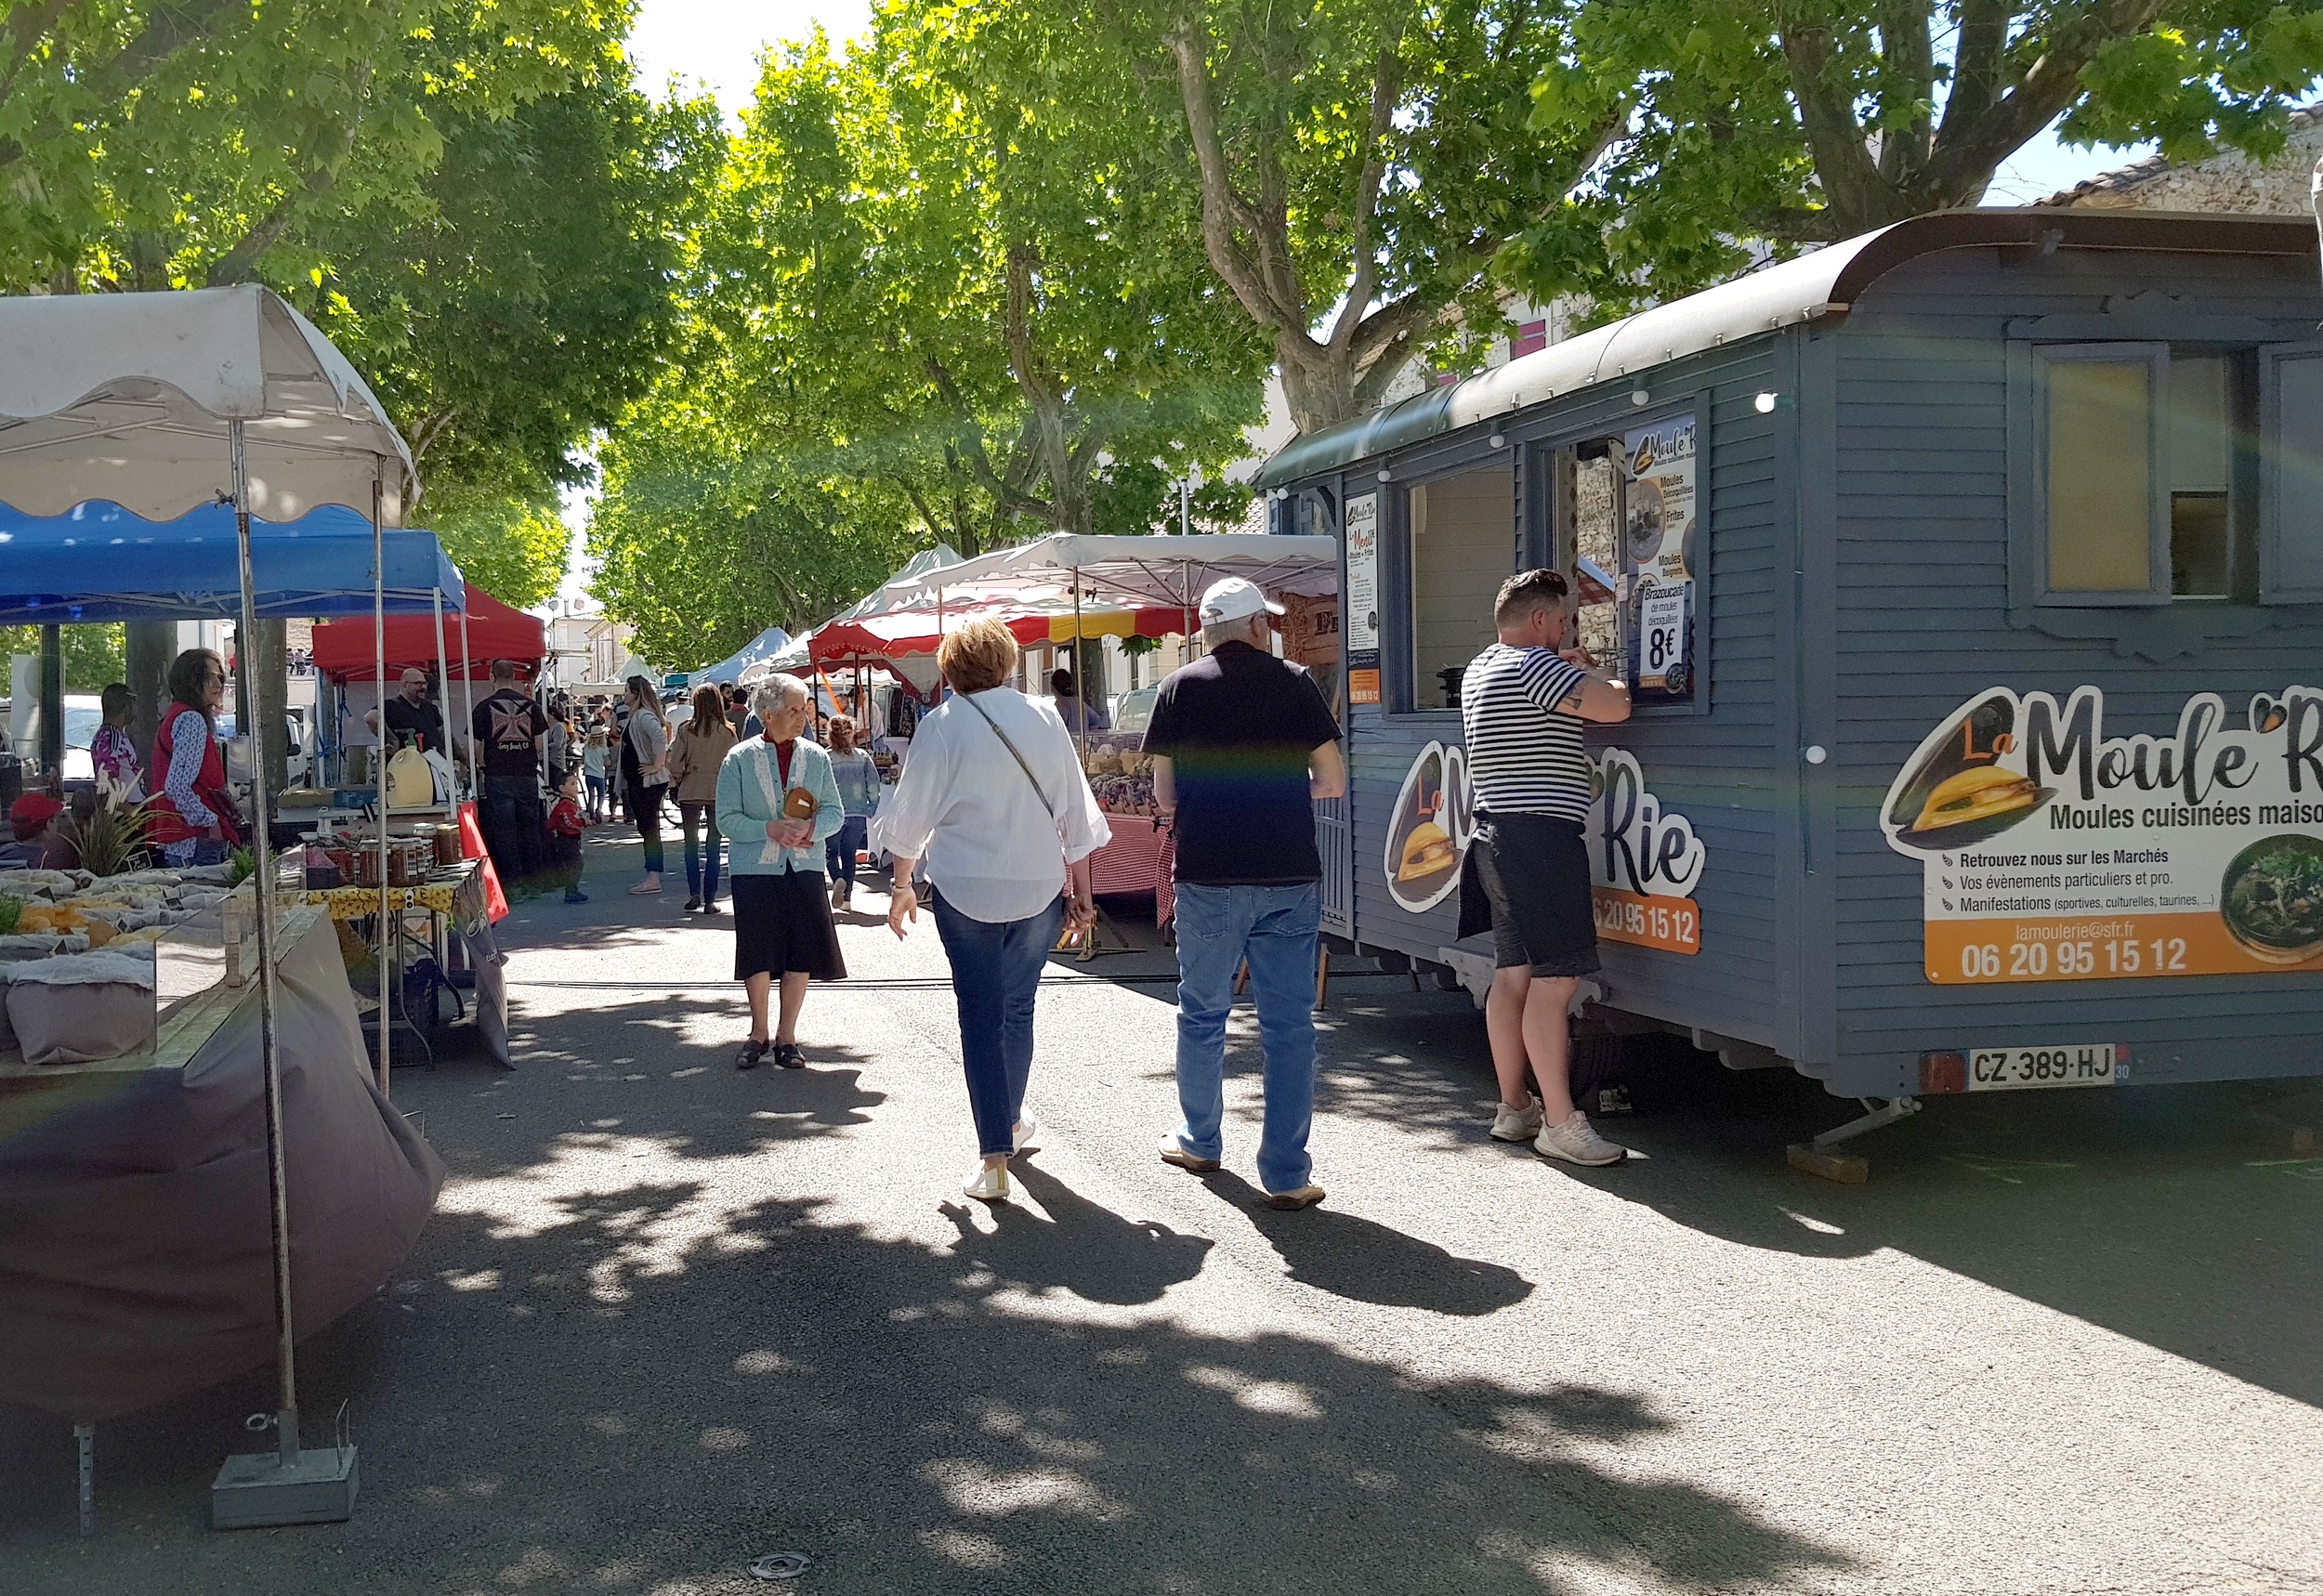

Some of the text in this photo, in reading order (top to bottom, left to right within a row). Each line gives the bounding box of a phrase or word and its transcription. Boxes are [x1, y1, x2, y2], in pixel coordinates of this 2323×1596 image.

[1650, 430, 1686, 459] Moule
[1660, 475, 1683, 488] Moules
[1667, 510, 1685, 522] Frites
[1354, 529, 1372, 550] Menu
[1659, 554, 1681, 567] Moules
[1662, 567, 1683, 578] Beignets
[1645, 583, 1684, 600] Brazoucade
[1650, 600, 1677, 613] de moules
[1649, 628, 1675, 670] 8€
[1962, 715, 2018, 761] La
[2027, 695, 2259, 806] Moule
[1417, 774, 1444, 816] La
[2050, 804, 2134, 830] Moules
[2142, 800, 2251, 828] cuisinées
[1600, 759, 1698, 897] Rie
[1961, 847, 2169, 868] Retrouvez nous sur les Marchés
[1960, 871, 2173, 890] Vos évènements particuliers et pro.
[1961, 896, 2051, 911] Manifestations
[2054, 896, 2104, 911] (sportives,
[2106, 896, 2157, 909] culturelles,
[2159, 895, 2199, 908] taurines,
[1604, 899, 1622, 931] 20
[1625, 903, 1645, 935] 95
[1648, 907, 1669, 939] 15
[1673, 910, 1694, 944] 12
[2015, 921, 2135, 941] lamoulerie@sfr.fr
[1962, 937, 2186, 977] 06 20 95 15 12
[2115, 1065, 2130, 1079] 30
